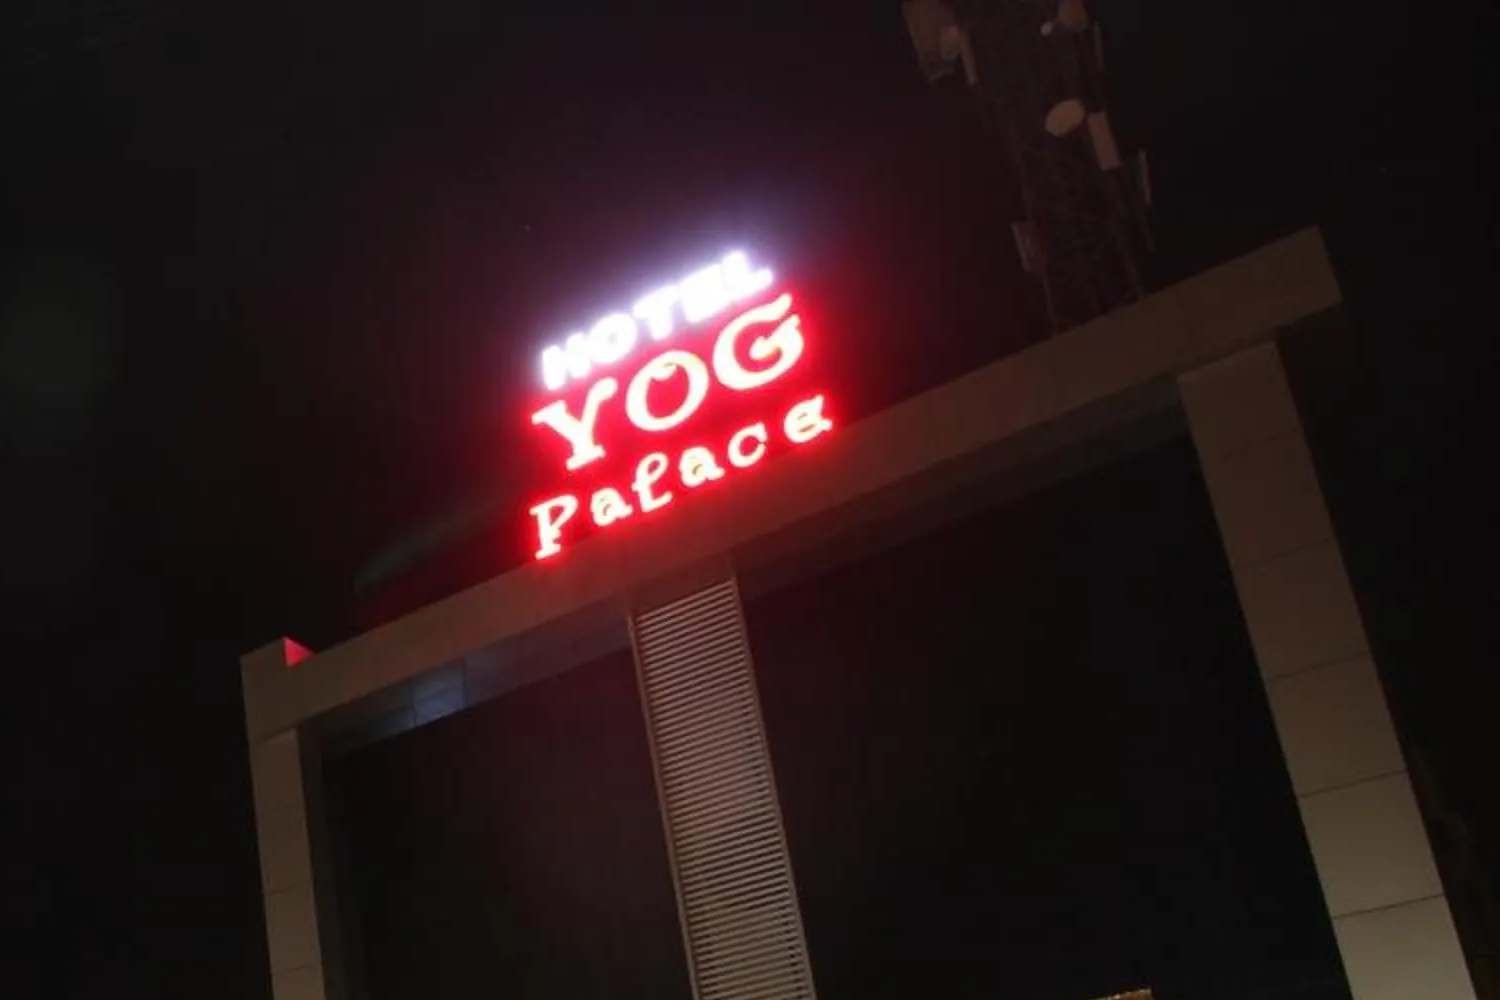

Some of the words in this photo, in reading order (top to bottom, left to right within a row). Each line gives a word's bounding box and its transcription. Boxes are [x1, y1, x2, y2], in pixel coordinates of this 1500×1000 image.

[531, 293, 804, 470] YOG
[541, 250, 773, 390] HOTEL
[530, 396, 832, 559] Palace
